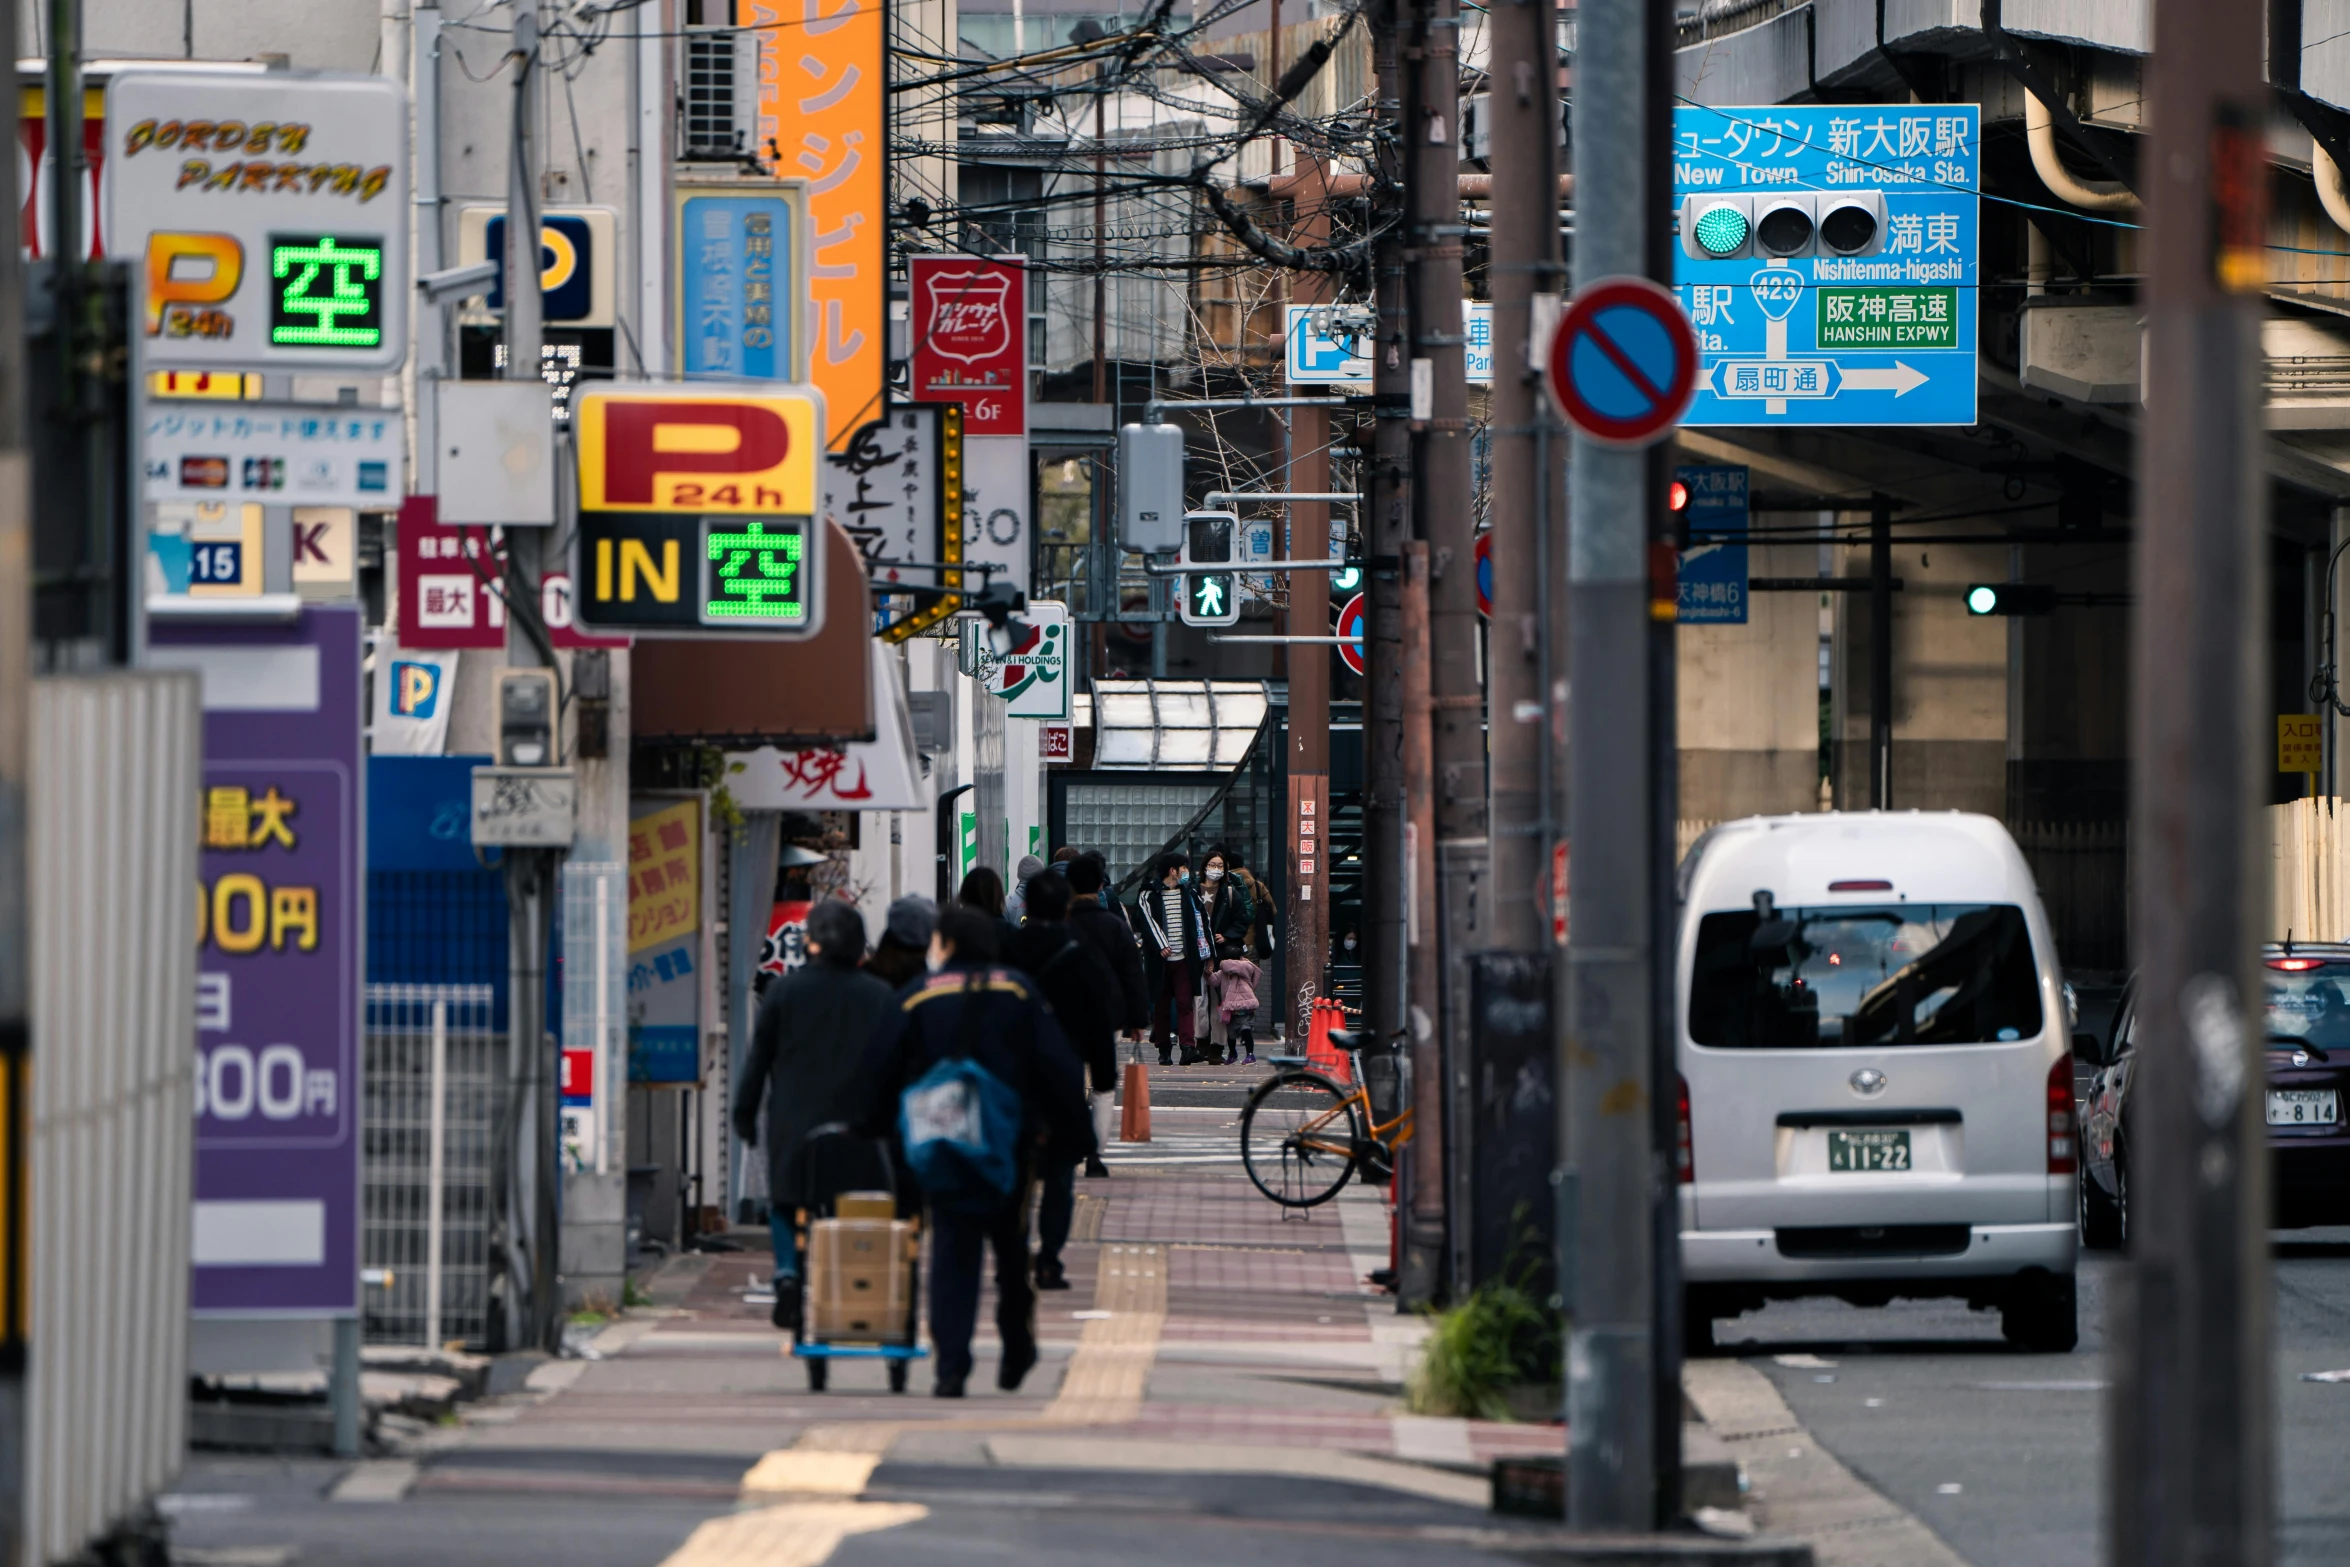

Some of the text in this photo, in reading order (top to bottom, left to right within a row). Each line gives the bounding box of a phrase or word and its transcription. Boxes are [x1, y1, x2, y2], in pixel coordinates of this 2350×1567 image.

[125, 119, 311, 157] GORDEN
[1672, 116, 1970, 158] ュータウン 新大阪駅
[175, 158, 393, 204] PARKING
[1674, 160, 1970, 185] New Town Shin-osaka Sta.
[145, 231, 244, 337] P
[1812, 257, 1963, 285] Nishitenma-higashi
[272, 237, 381, 346] 空
[1754, 277, 1797, 301] 423
[1825, 294, 1949, 323] 阪神高速
[1823, 326, 1950, 342] HANSHIN EXPWY
[1734, 367, 1819, 392] 扇町通
[974, 397, 1001, 421] 6F
[605, 401, 789, 504] P
[672, 483, 784, 506] 24h
[596, 539, 680, 603] IN
[707, 522, 802, 618] 空
[1018, 655, 1063, 666] HOLDINGS
[399, 664, 433, 714] P
